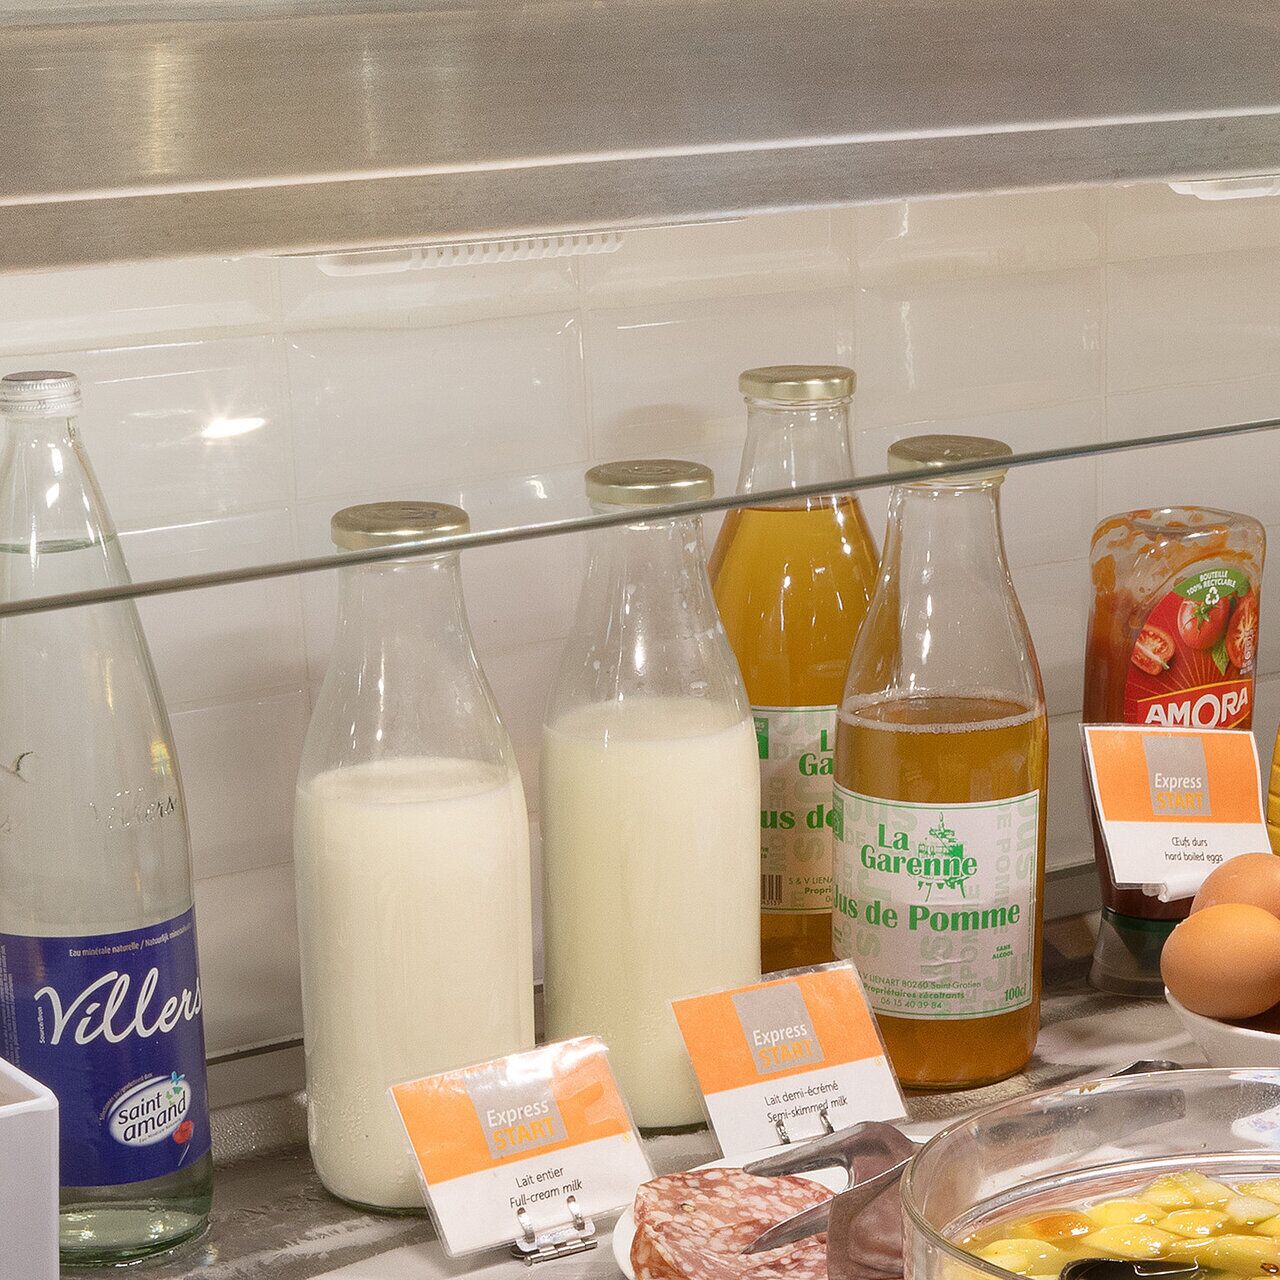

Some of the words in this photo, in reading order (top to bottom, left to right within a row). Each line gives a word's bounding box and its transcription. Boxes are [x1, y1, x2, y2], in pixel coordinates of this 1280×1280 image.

[1186, 582, 1203, 596] 100%
[1203, 577, 1237, 589] RECYCLABLE
[1199, 570, 1228, 582] BOUTEILLE
[1144, 687, 1249, 729] AMORA
[1154, 773, 1202, 792] Express
[1156, 791, 1203, 809] START
[760, 808, 796, 830] us
[878, 823, 910, 851] La
[1192, 837, 1208, 847] durs
[860, 844, 978, 877] Garenne
[1164, 852, 1181, 861] hard
[1183, 852, 1205, 861] boiled
[1206, 854, 1223, 864] eggs
[865, 900, 898, 929] de
[909, 903, 1021, 932] Pomme
[69, 949, 81, 957] Eau
[871, 976, 900, 987] LIENART
[1004, 983, 1027, 1002] 100cl
[33, 967, 203, 1045] Villers
[752, 1023, 808, 1047] Express
[758, 1039, 813, 1068] START
[764, 1093, 781, 1107] Lait
[782, 1080, 839, 1103] demi-écrémé
[118, 1092, 163, 1125] saint
[123, 1090, 187, 1142] amand
[486, 1100, 550, 1128] Express
[766, 1099, 829, 1123] Semi-skimmed
[830, 1095, 848, 1108] milk
[493, 1116, 555, 1151] START
[515, 1174, 535, 1188] Lait
[536, 1167, 564, 1182] entier
[509, 1186, 560, 1208] Full-cream
[562, 1179, 583, 1193] milk
